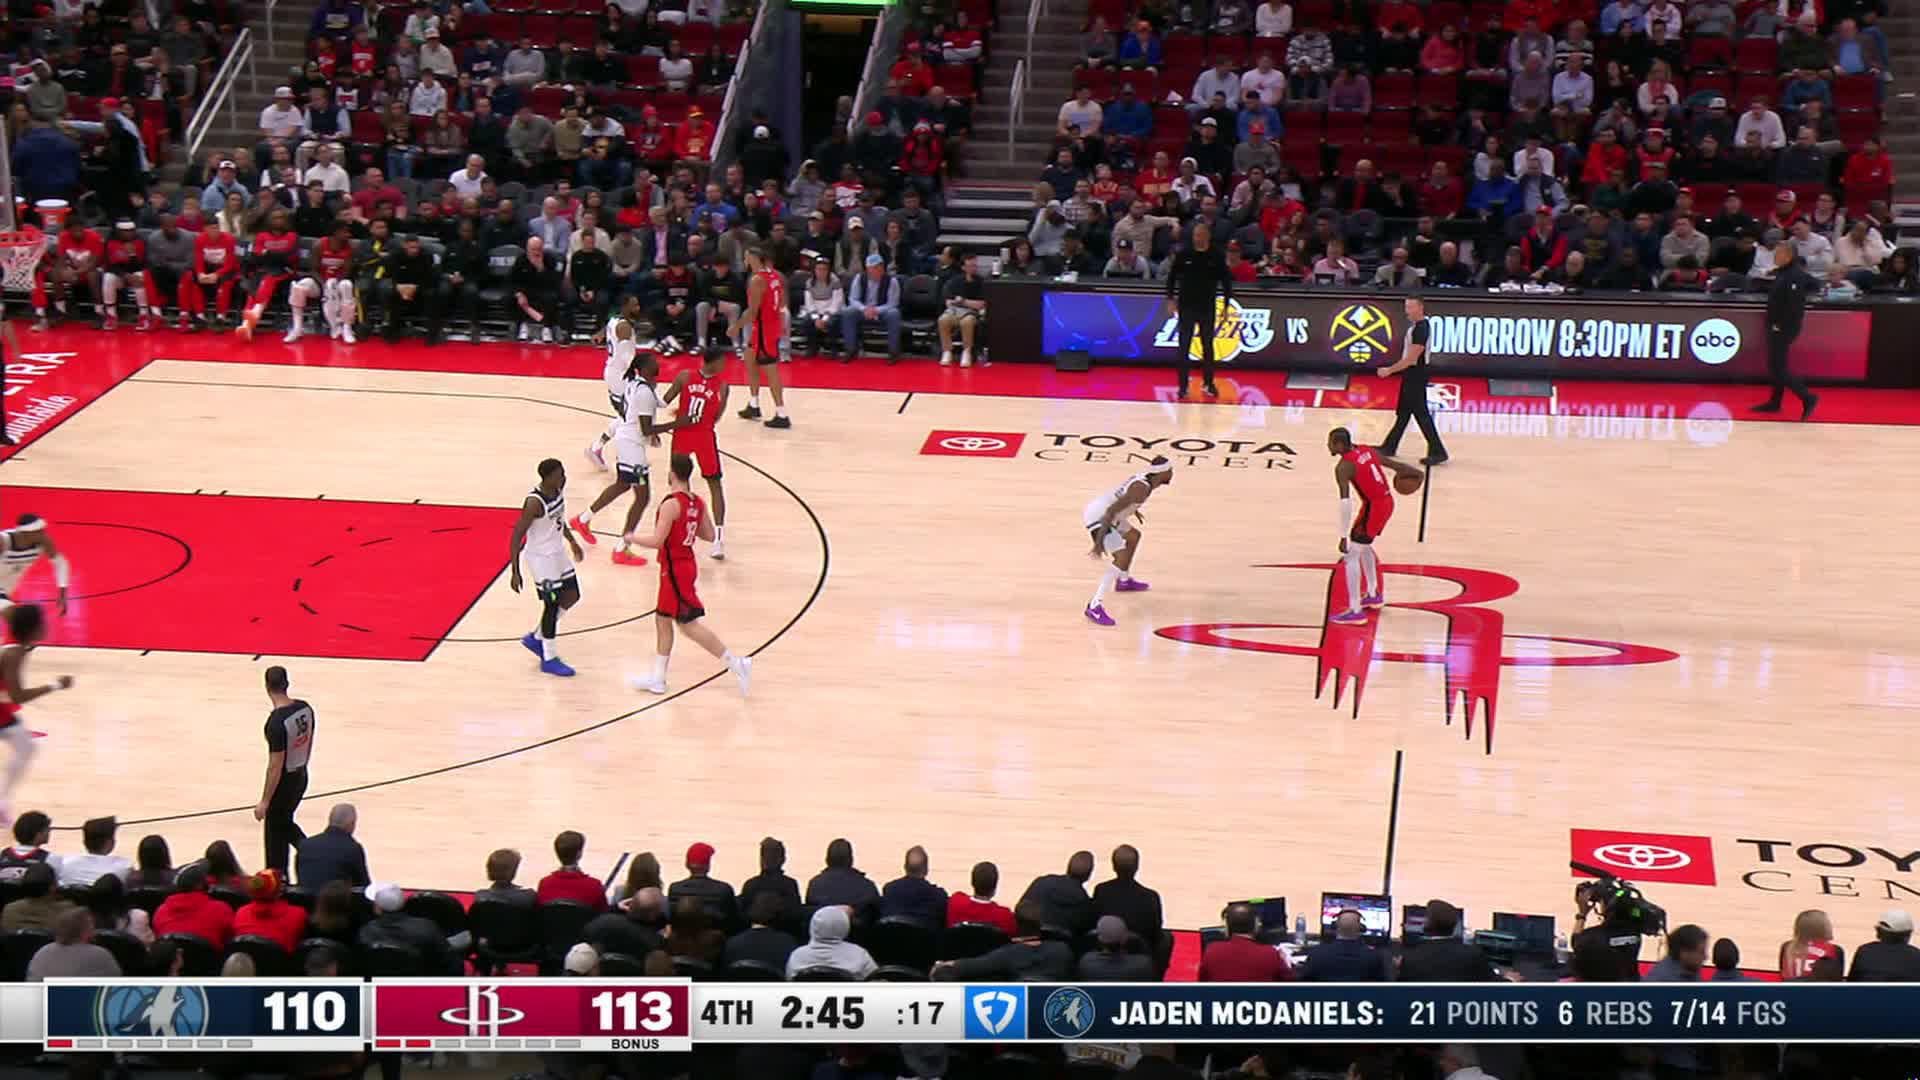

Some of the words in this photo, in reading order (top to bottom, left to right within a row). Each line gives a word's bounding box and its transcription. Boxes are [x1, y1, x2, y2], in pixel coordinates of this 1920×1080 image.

[1286, 317, 1309, 344] VS
[1425, 315, 1556, 356] OMORROW
[1559, 319, 1651, 359] 8:30PM
[1655, 323, 1686, 360] ET
[1695, 331, 1736, 348] abc
[1043, 433, 1297, 455] TOYOTA
[1736, 838, 1920, 872] TOY
